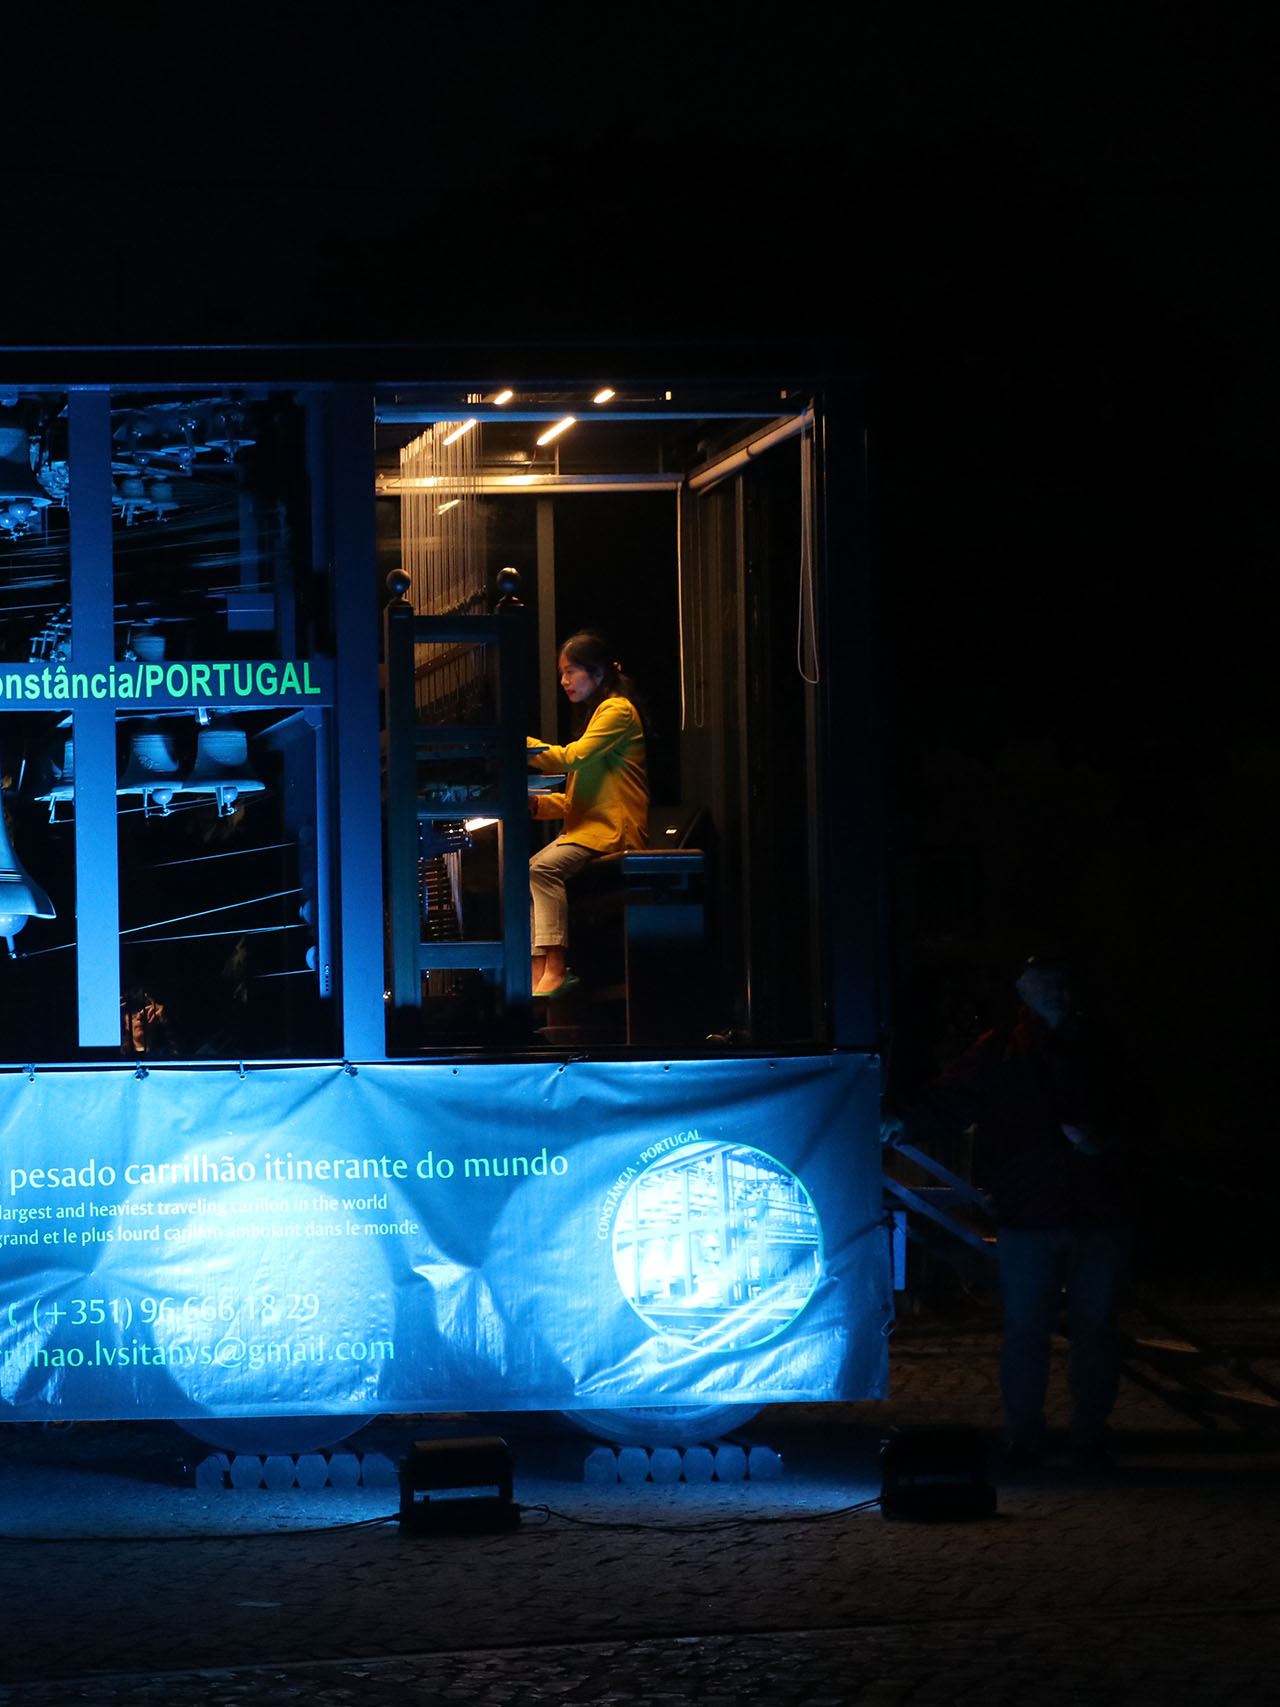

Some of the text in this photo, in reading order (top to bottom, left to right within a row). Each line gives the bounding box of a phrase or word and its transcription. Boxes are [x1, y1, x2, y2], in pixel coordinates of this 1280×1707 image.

[10, 1158, 116, 1196] pesado
[124, 1154, 256, 1185] carrilhão
[264, 1152, 409, 1181] itinerante
[416, 1150, 455, 1179] do
[464, 1148, 569, 1178] mundo
[596, 1128, 703, 1240] CONSTÂNCIA PORTUGAL
[56, 1201, 86, 1220] and
[90, 1199, 154, 1218] heaviest
[312, 1195, 338, 1211] the
[342, 1193, 388, 1211] world
[43, 1229, 60, 1244] et
[63, 1228, 78, 1243] le
[81, 1226, 114, 1246] plus
[117, 1224, 160, 1242] lourd
[304, 1220, 342, 1238] dans
[345, 1220, 360, 1236] le
[364, 1218, 419, 1236] monde
[32, 1298, 134, 1331] (+351)
[141, 1297, 175, 1325] 96
[288, 1292, 321, 1321] 29
